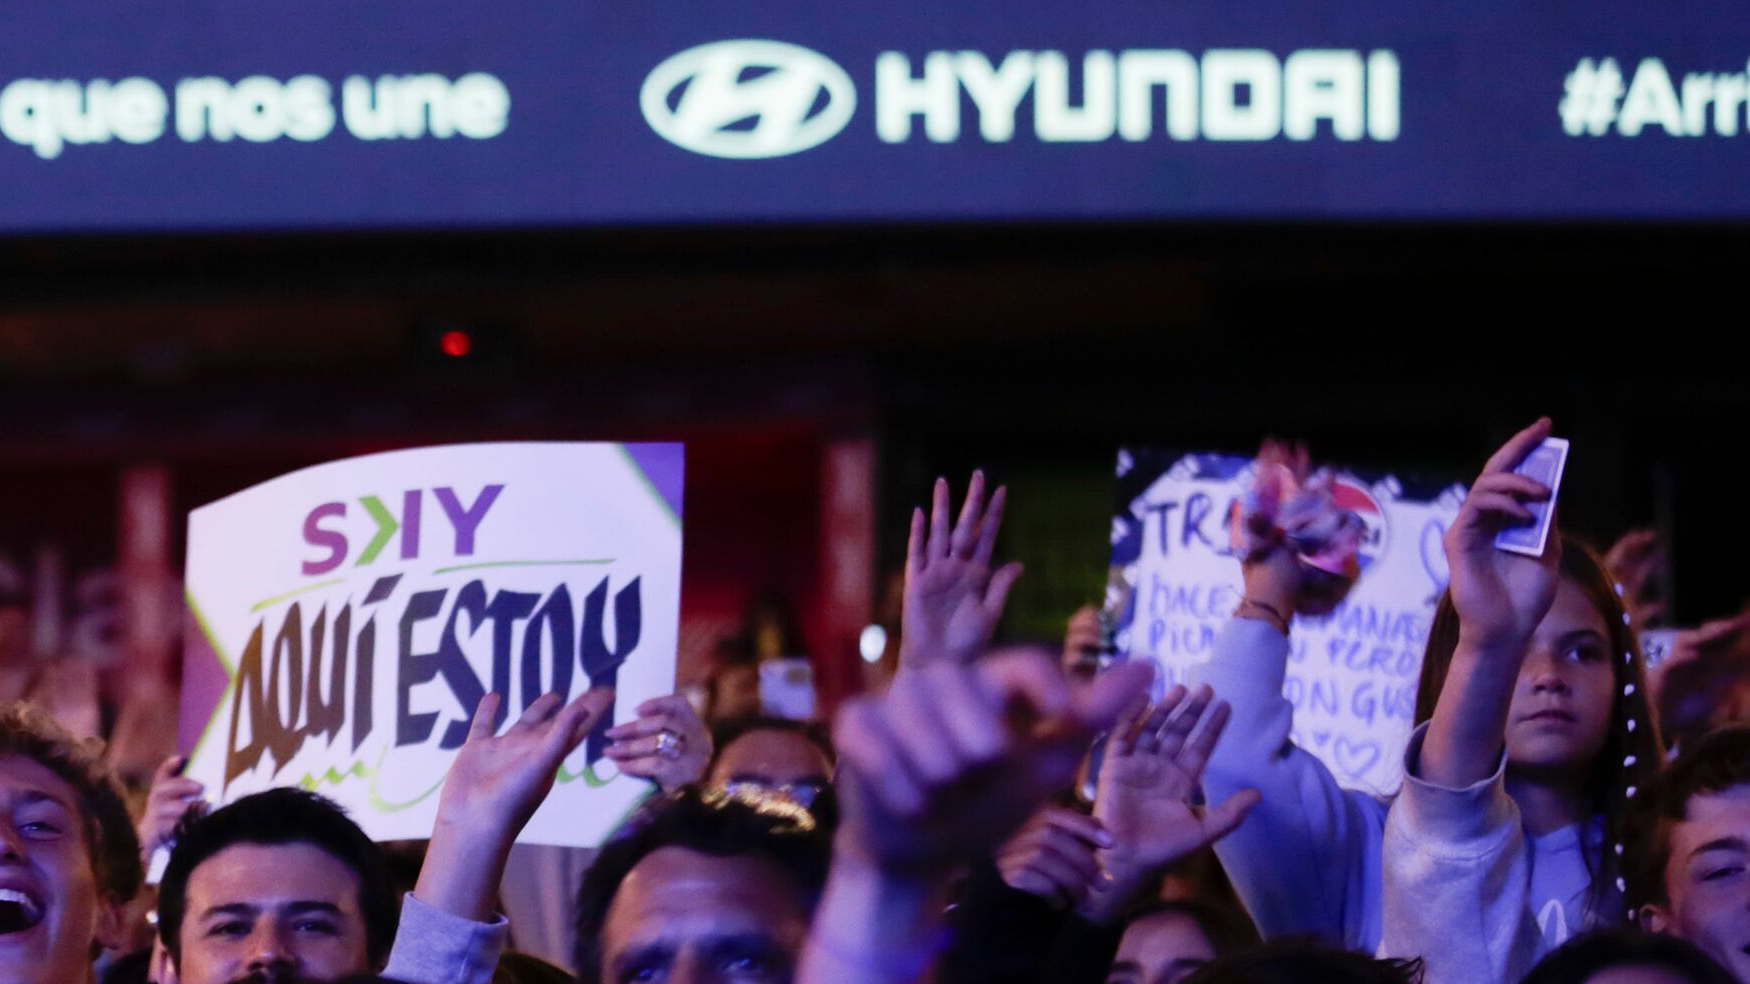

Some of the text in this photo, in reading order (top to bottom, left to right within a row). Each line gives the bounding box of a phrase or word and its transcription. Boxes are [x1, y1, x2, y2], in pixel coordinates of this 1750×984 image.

[175, 75, 335, 142] nos
[342, 73, 509, 141] une
[875, 50, 1400, 143] HYUNDAI
[1558, 57, 1750, 137] #Arr
[222, 572, 642, 797] AQUÍ ESTOY
